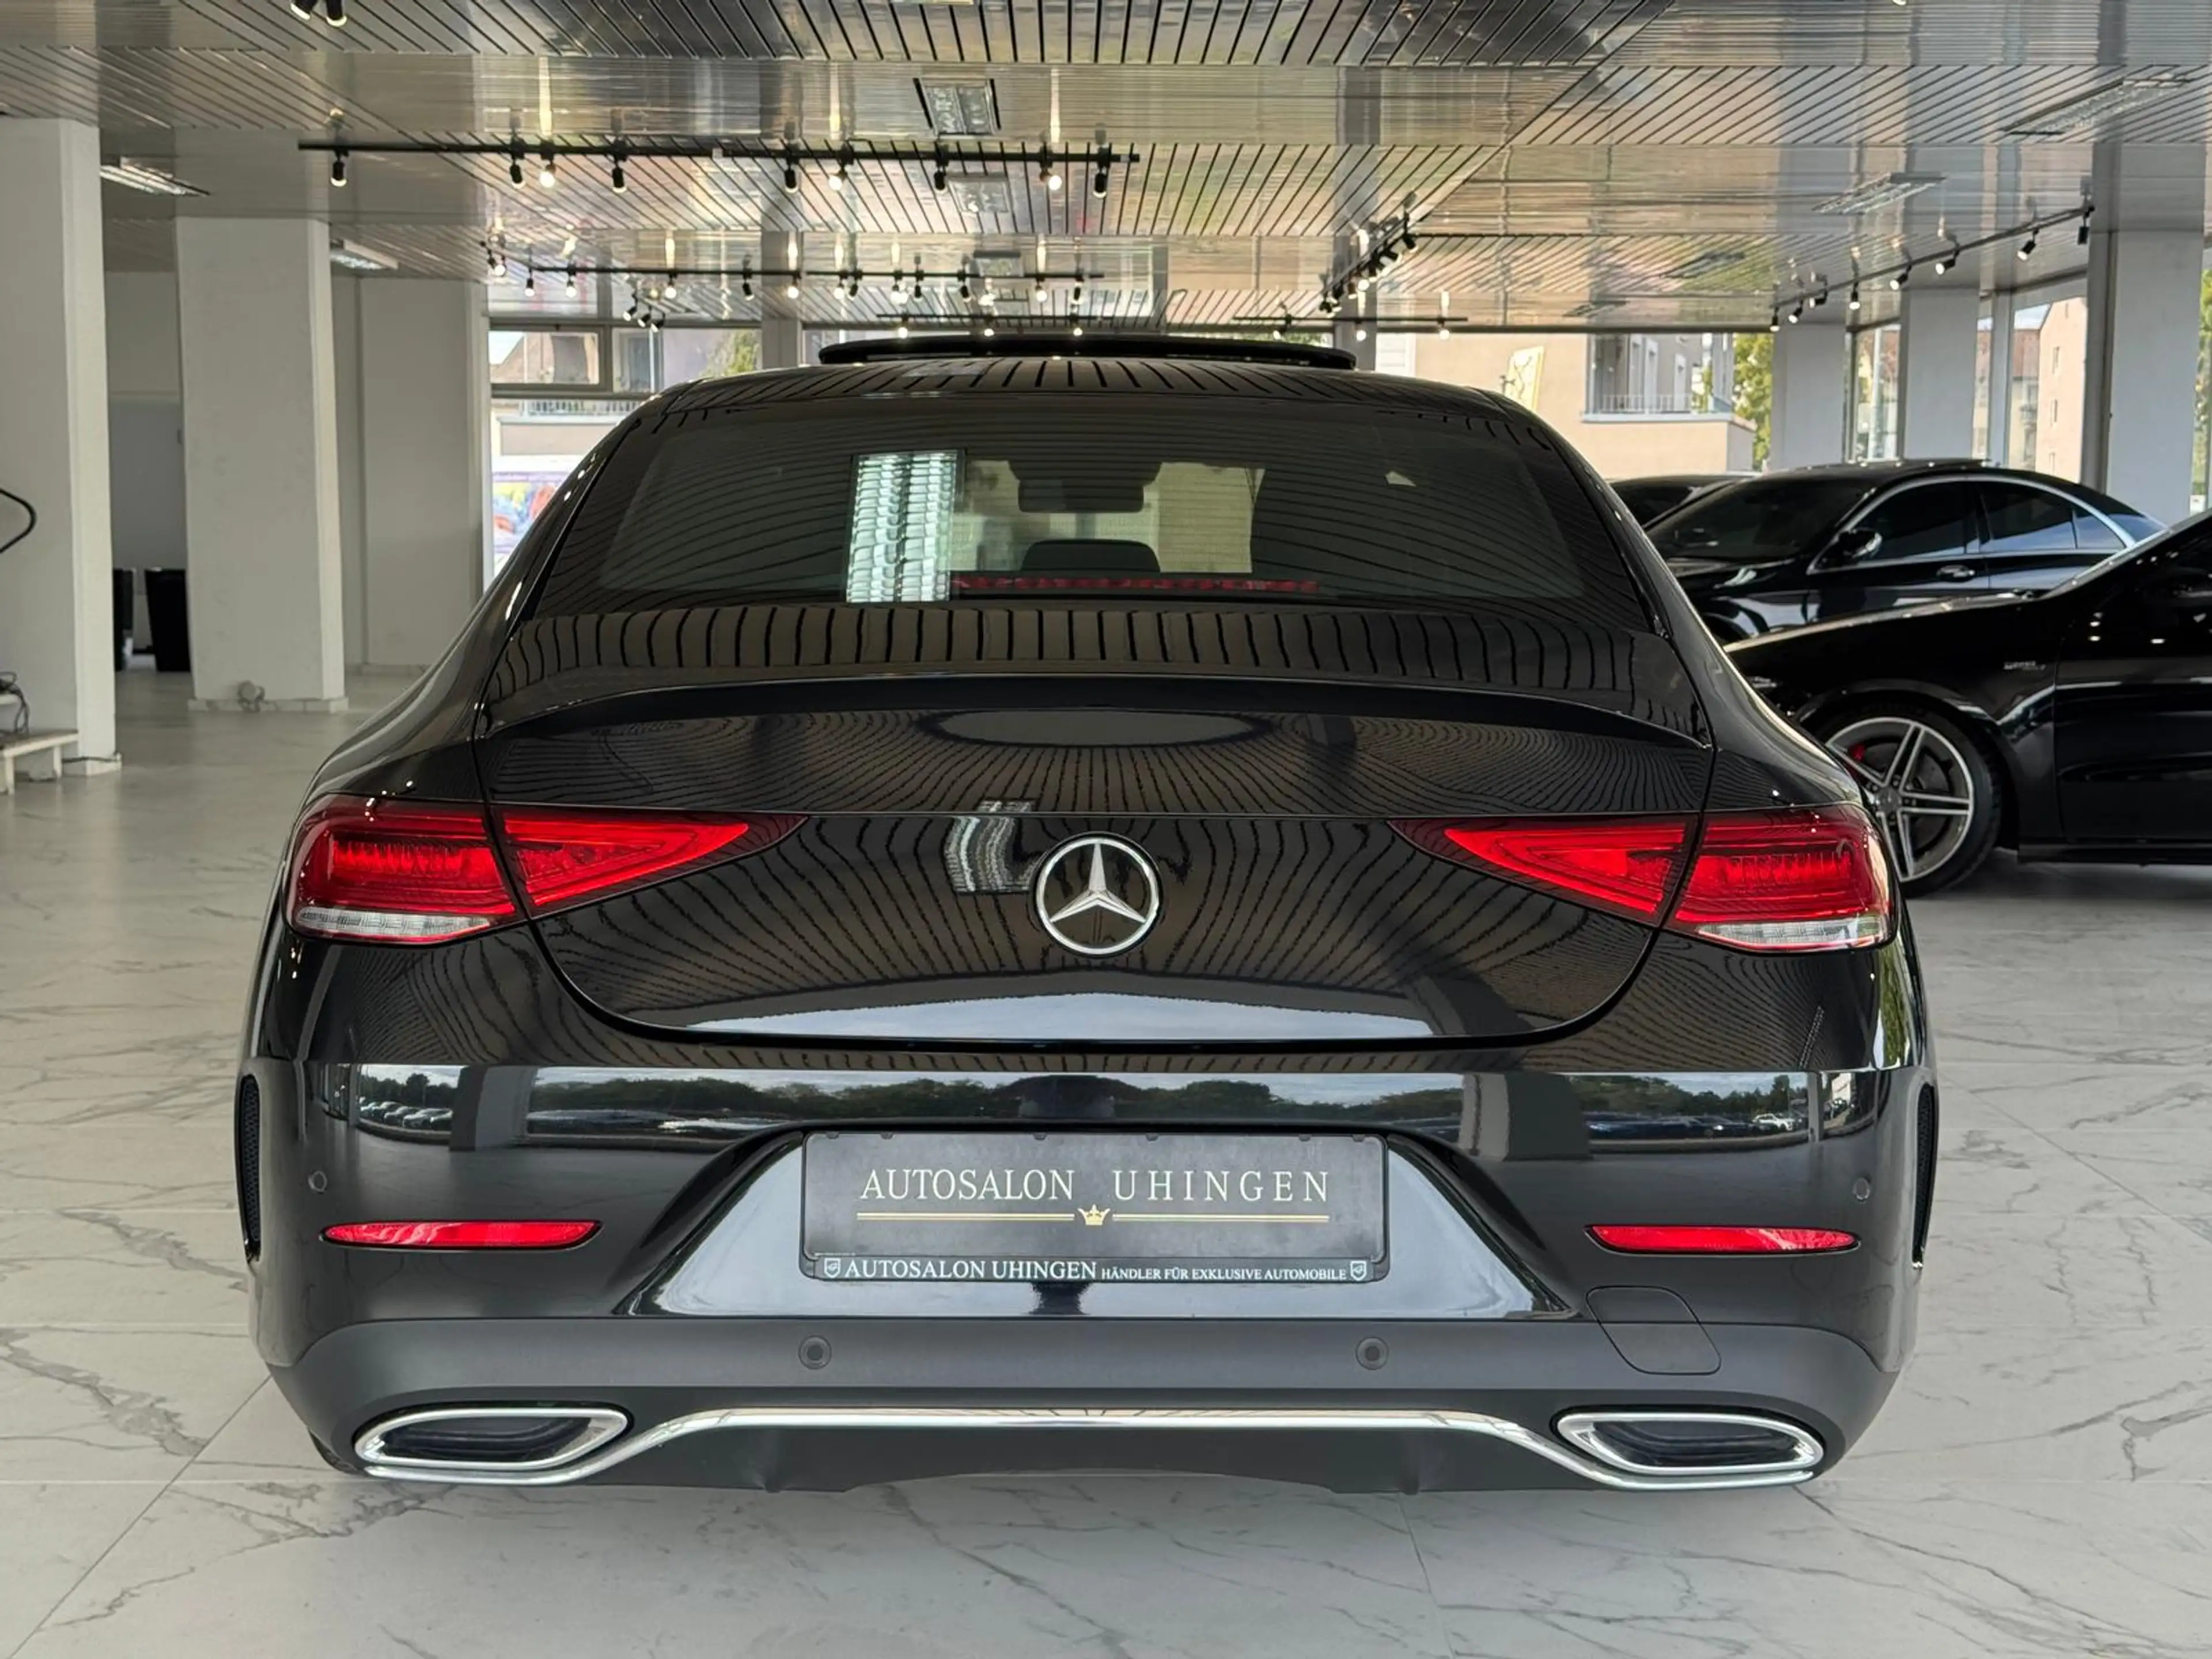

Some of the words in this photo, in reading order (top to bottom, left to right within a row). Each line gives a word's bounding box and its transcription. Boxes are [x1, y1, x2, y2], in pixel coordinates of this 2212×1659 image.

[859, 1169, 1075, 1200] AUTOSALON
[1112, 1170, 1328, 1202] UHINGEN
[844, 1259, 986, 1278] AUTOSALON
[992, 1260, 1097, 1279] UHINGEN
[1101, 1267, 1161, 1280] HÄNDLER
[1164, 1267, 1188, 1280] FÜR
[1192, 1268, 1262, 1280] EXKLUSIVE
[1264, 1268, 1346, 1280] AUTOMOBILE
